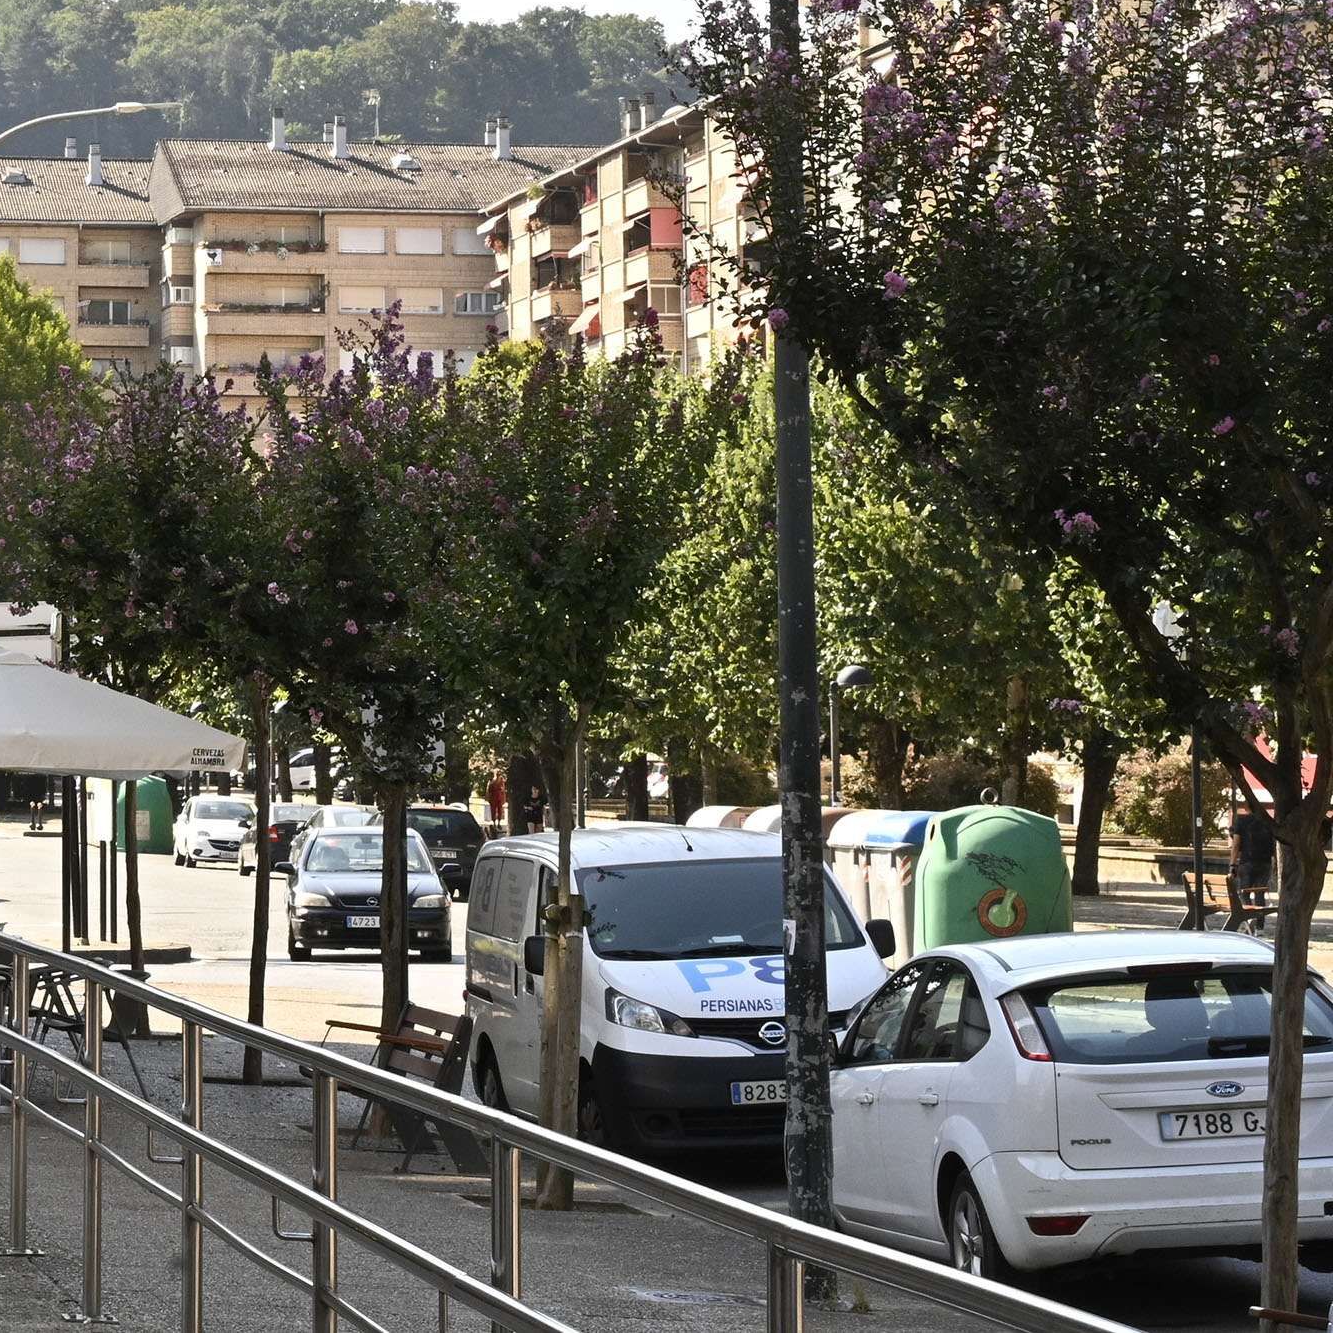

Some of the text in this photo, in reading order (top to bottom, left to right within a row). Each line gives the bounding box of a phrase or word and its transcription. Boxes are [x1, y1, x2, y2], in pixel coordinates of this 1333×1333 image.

[193, 748, 225, 757] CERVEZAS
[190, 757, 225, 766] ALHAMBRA
[352, 917, 376, 927] 4723
[700, 998, 773, 1012] PERSIANAS
[744, 1084, 787, 1101] 8283
[1175, 1112, 1234, 1136] 7188
[1070, 1138, 1111, 1146] FOCUS
